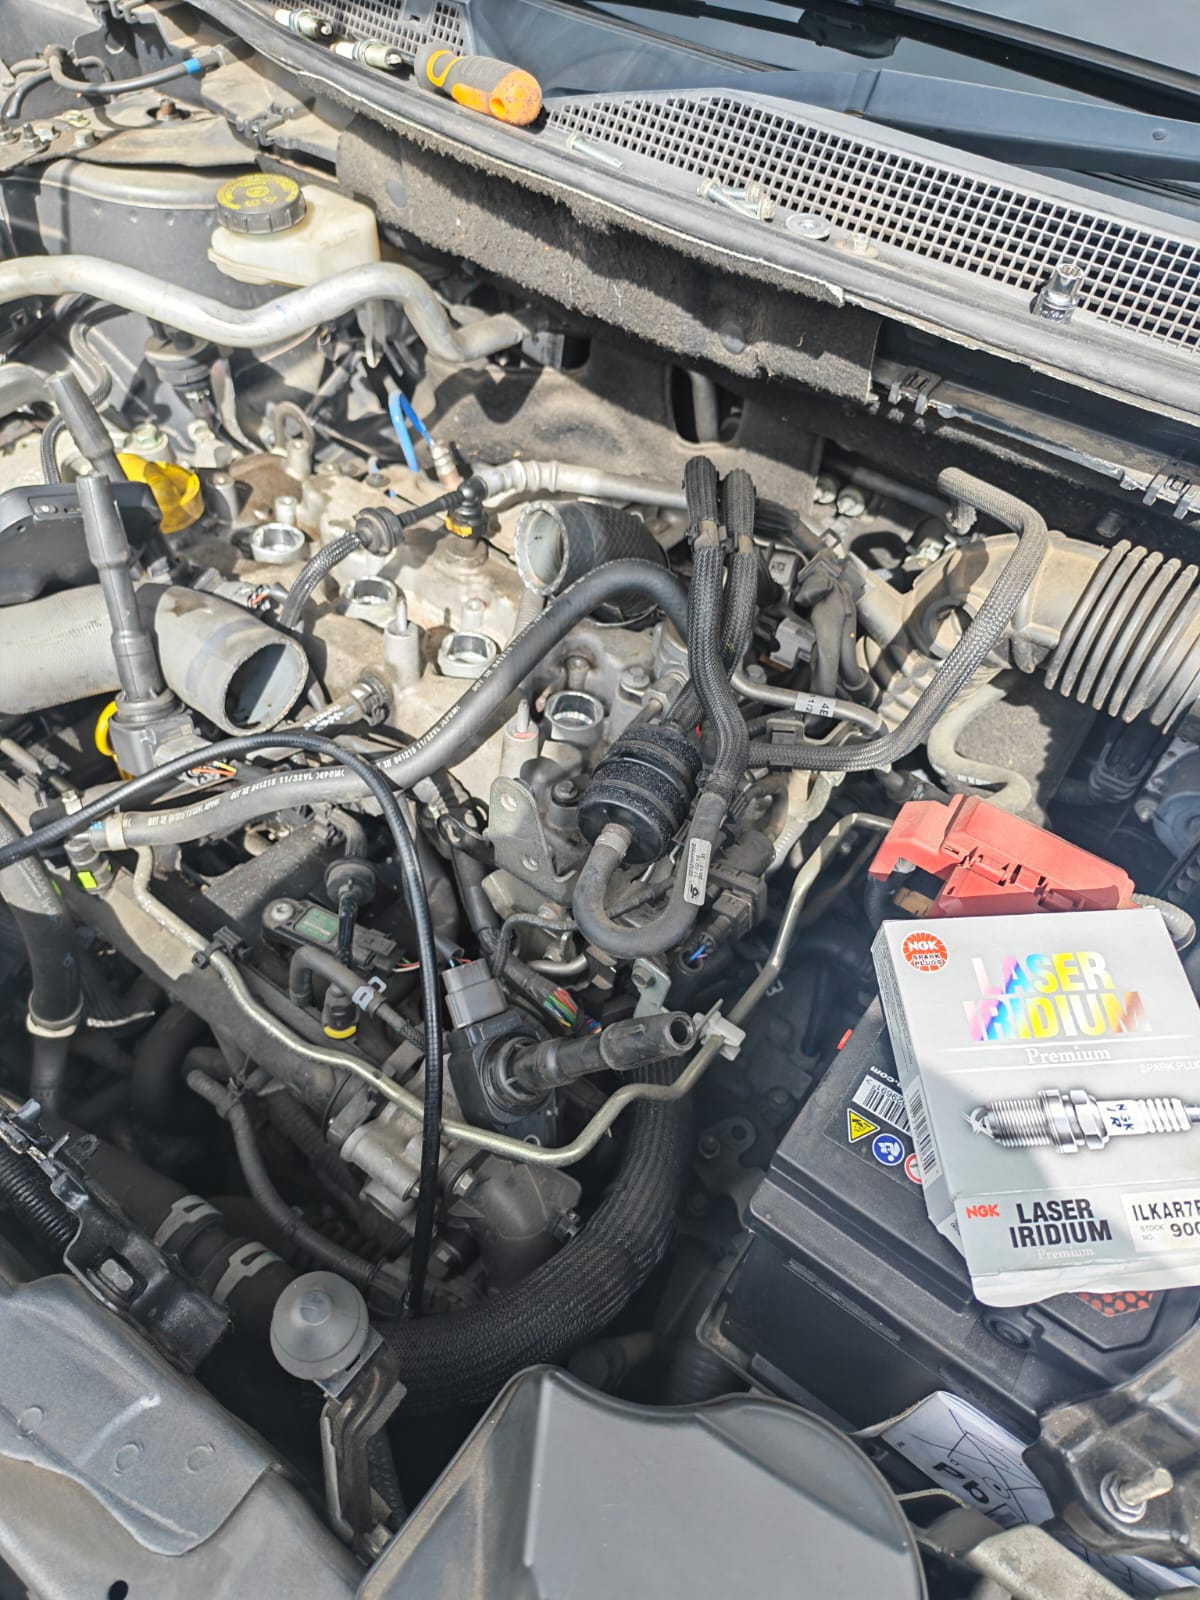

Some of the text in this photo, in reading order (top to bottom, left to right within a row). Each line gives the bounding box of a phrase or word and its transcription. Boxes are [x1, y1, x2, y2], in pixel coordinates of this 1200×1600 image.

[908, 941, 940, 951] NGK
[971, 951, 1116, 995] LASER
[963, 991, 1152, 1041] IRIDIUM
[1024, 1045, 1112, 1065] Premium
[965, 1204, 1000, 1219] NGK
[1016, 1198, 1094, 1224] LASER
[1009, 1219, 1113, 1248] IRIDIUM
[1038, 1246, 1095, 1260] Premium
